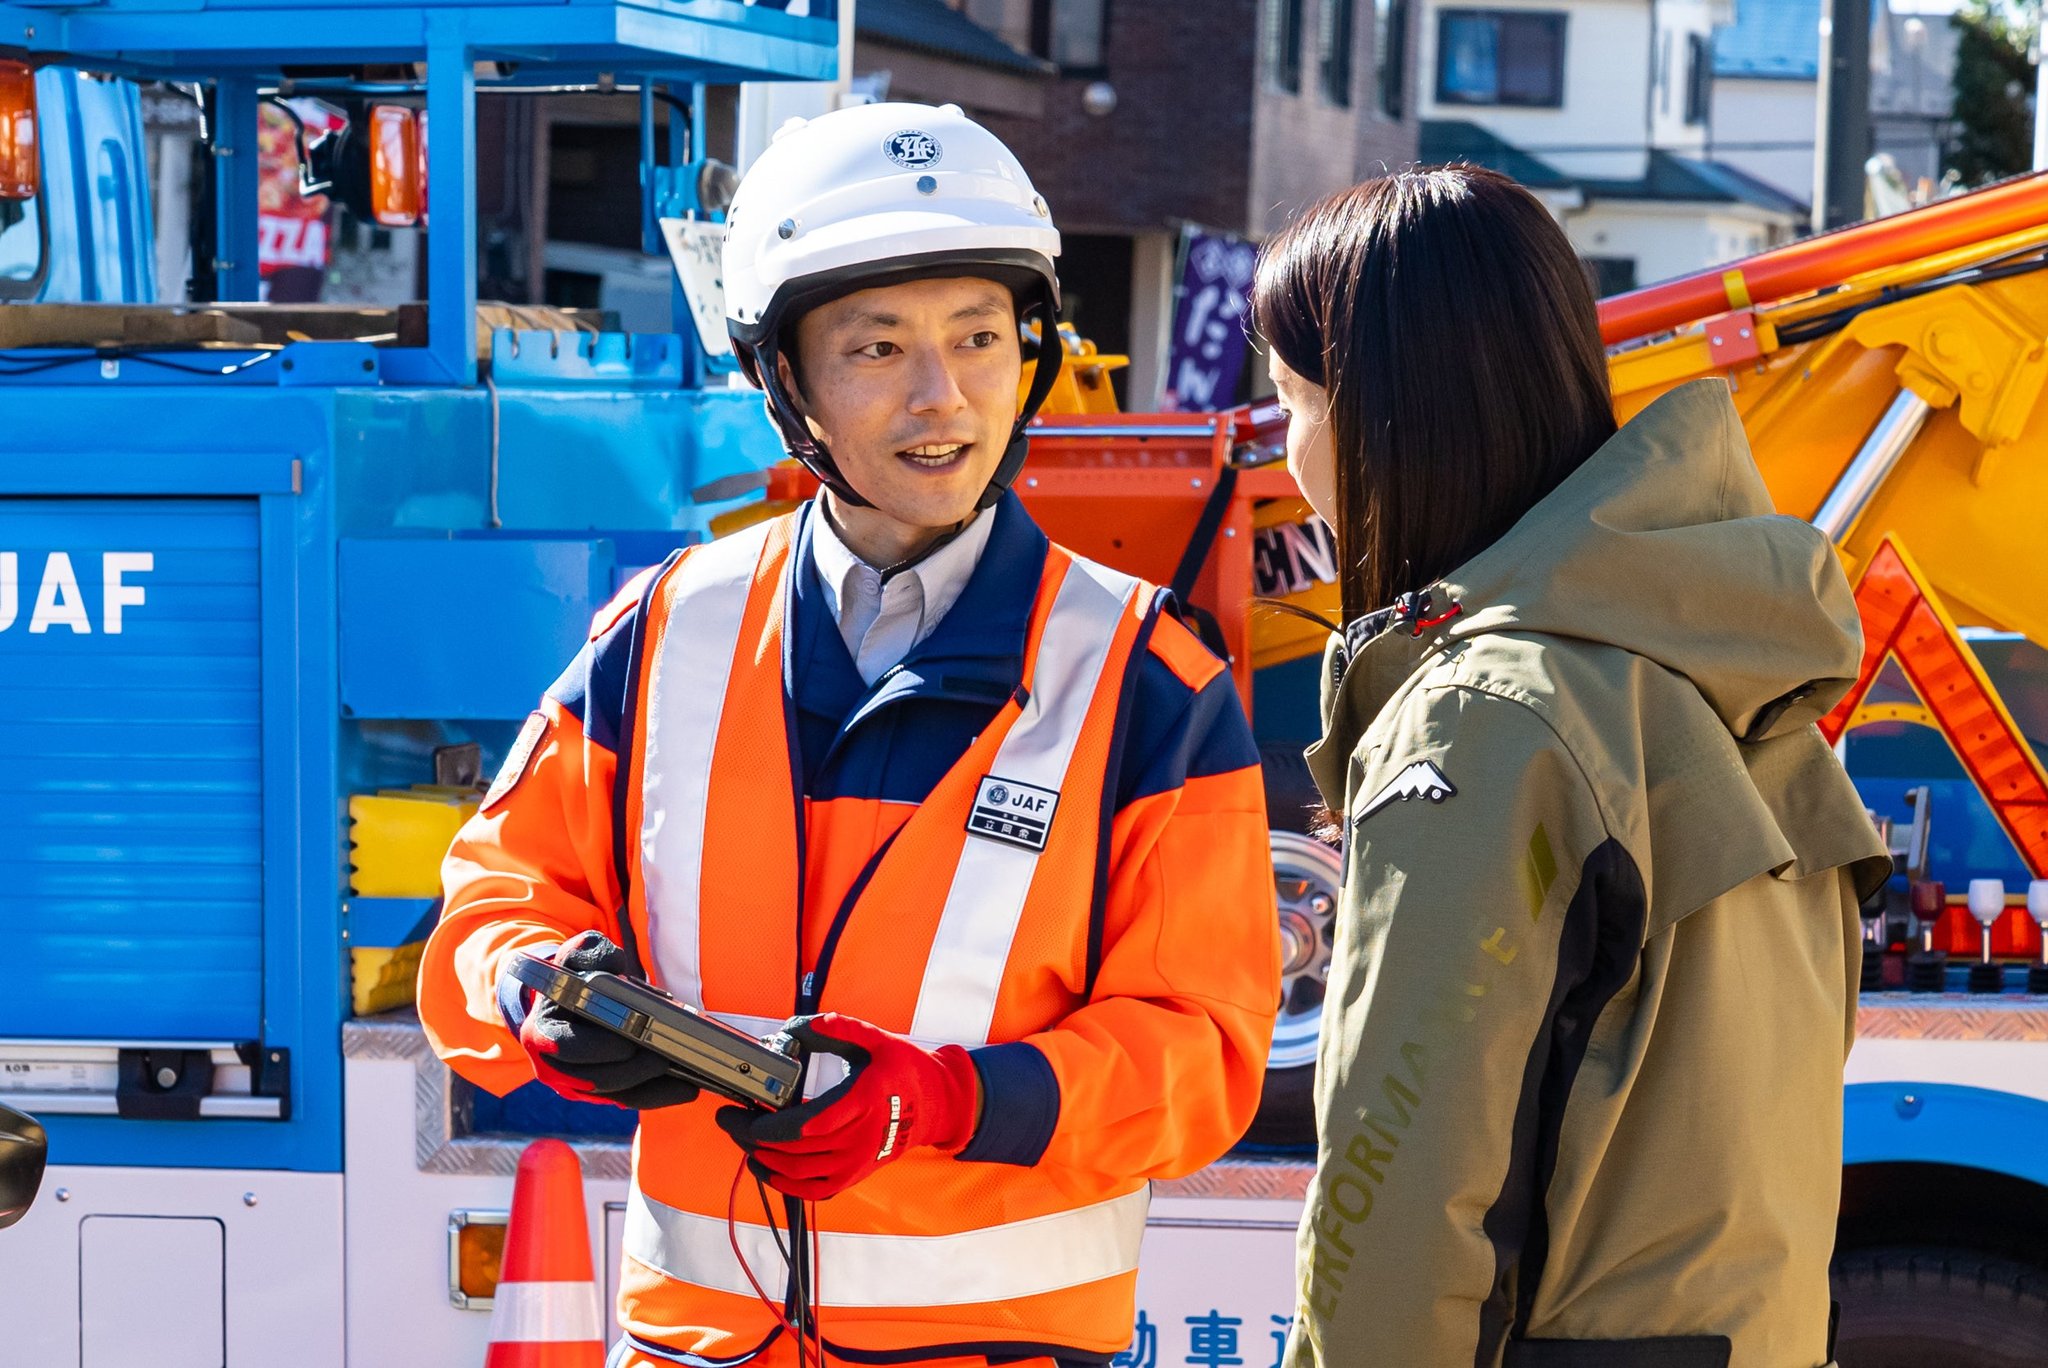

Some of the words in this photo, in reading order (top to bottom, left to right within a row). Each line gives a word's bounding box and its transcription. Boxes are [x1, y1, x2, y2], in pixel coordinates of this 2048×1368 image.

[258, 214, 328, 268] ZZA
[1177, 284, 1246, 411] だん
[1012, 793, 1048, 812] JAF
[890, 1095, 901, 1120] RED
